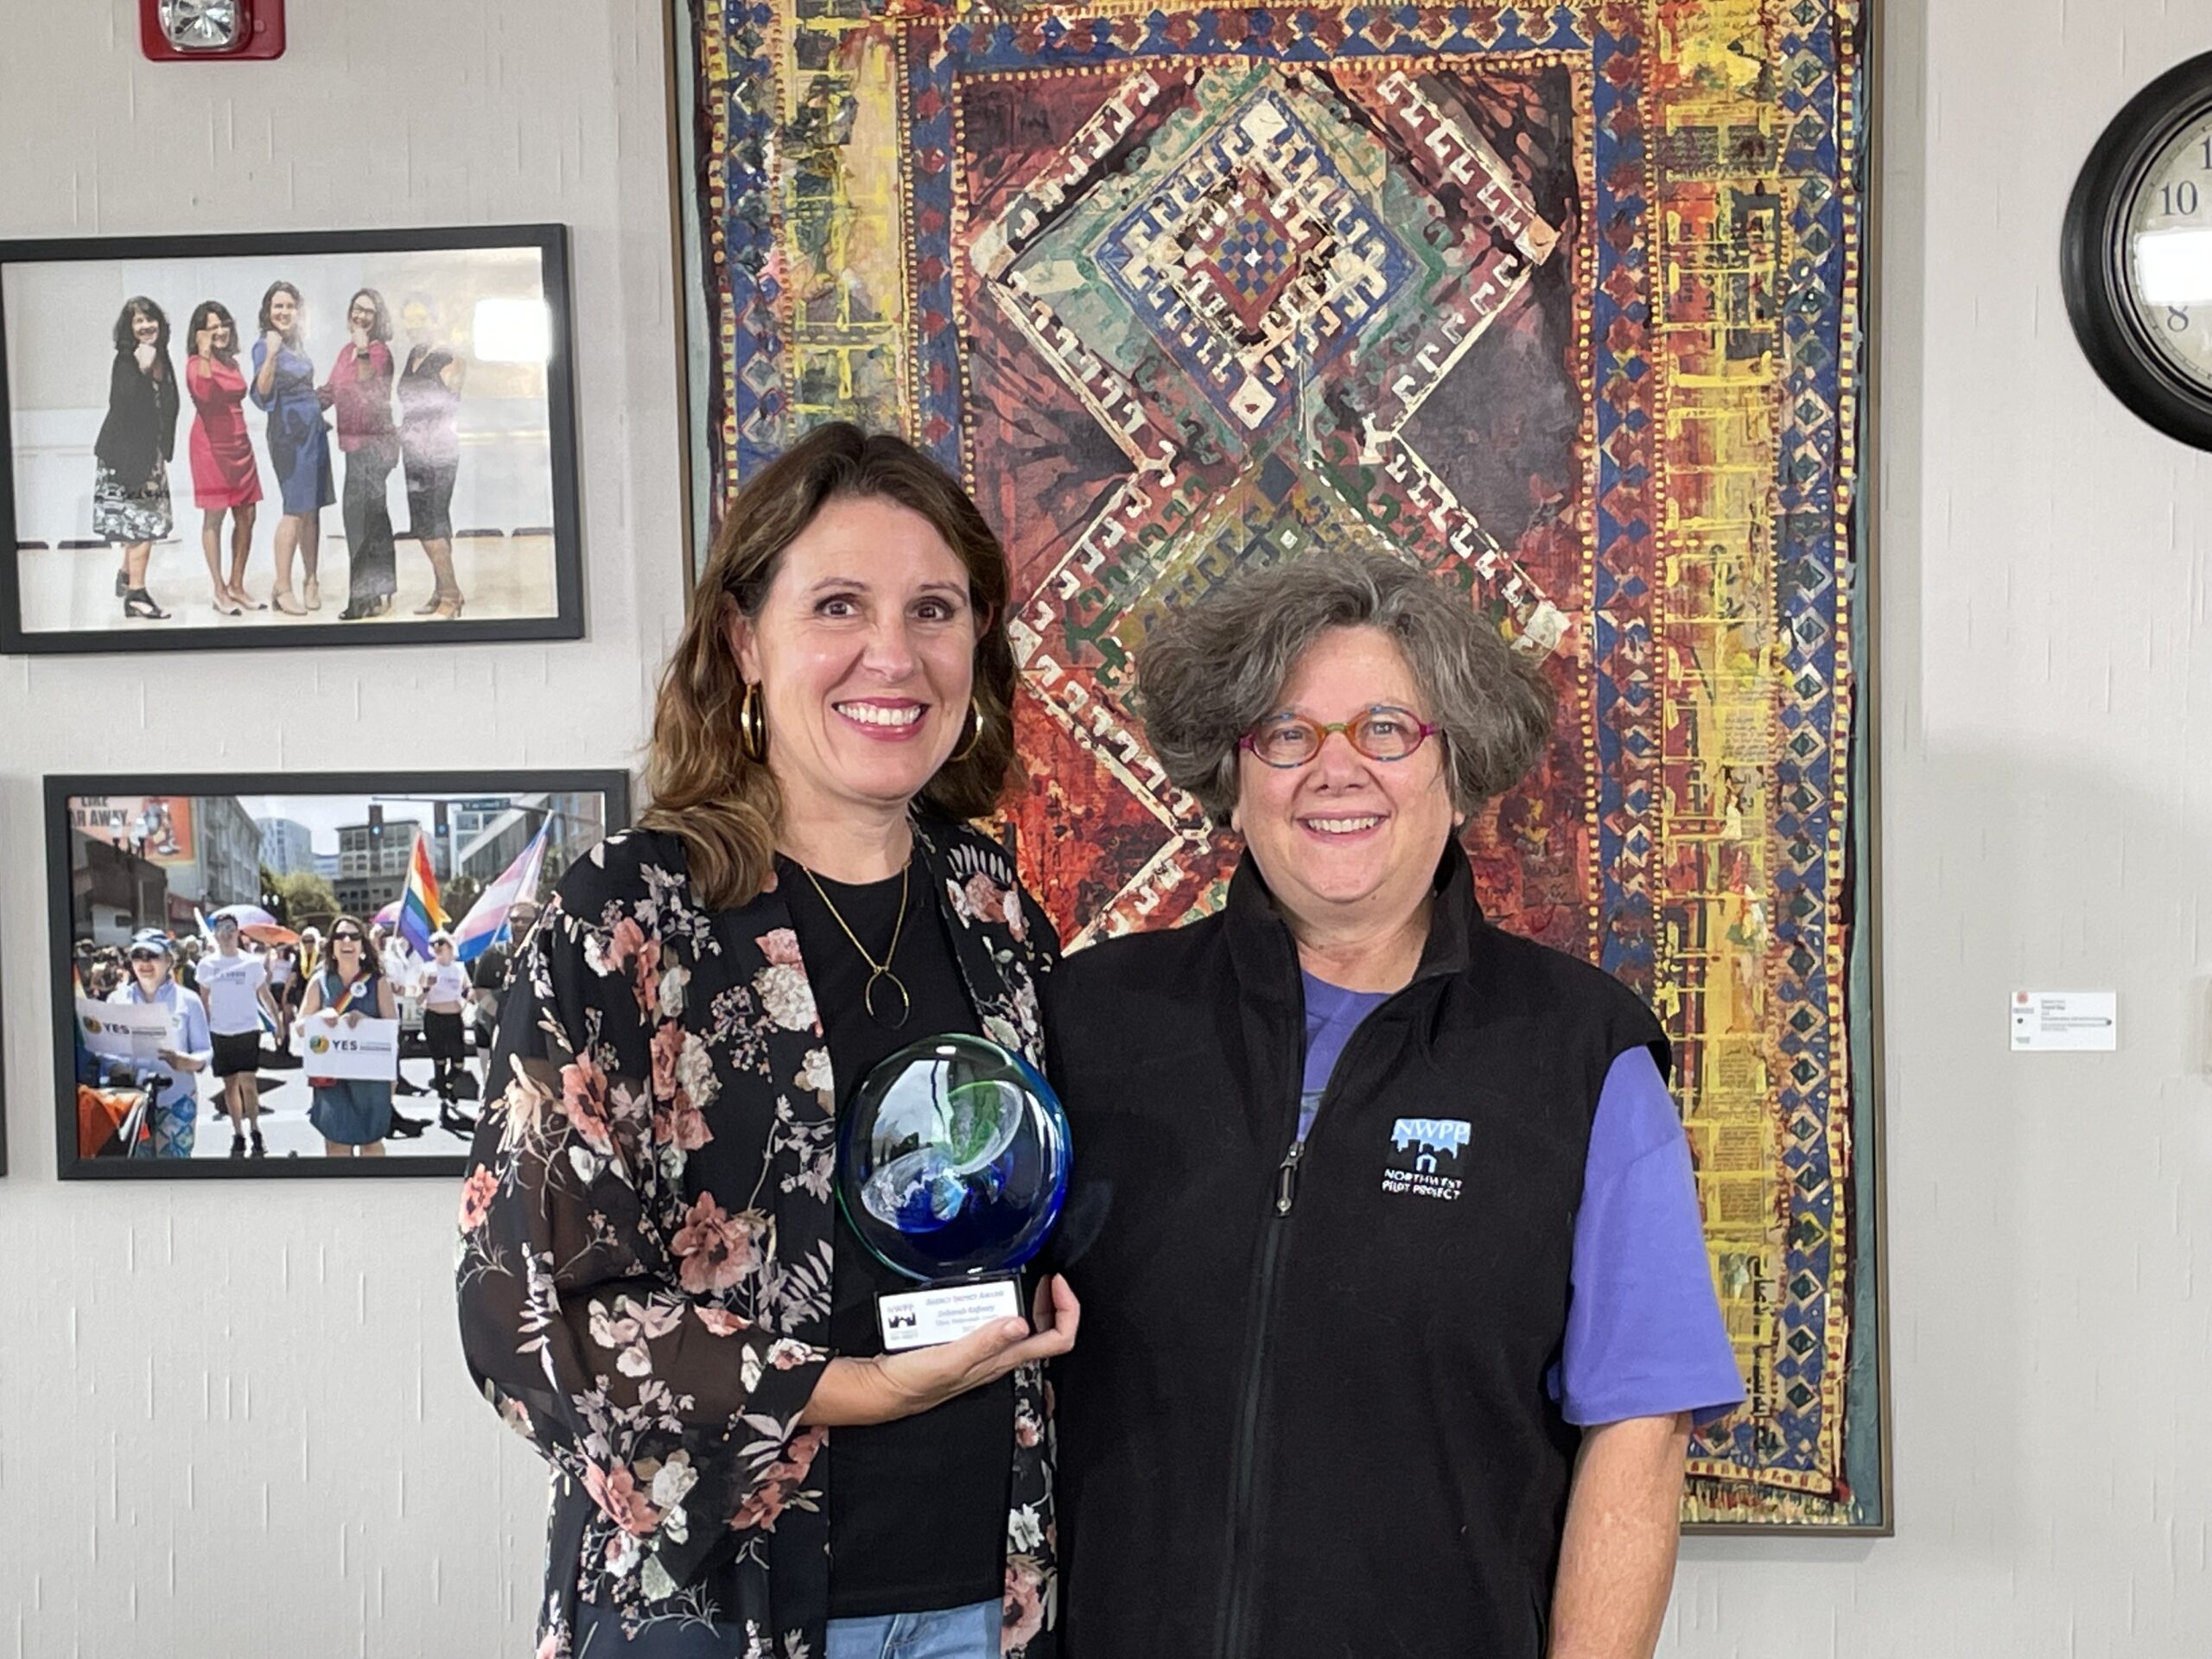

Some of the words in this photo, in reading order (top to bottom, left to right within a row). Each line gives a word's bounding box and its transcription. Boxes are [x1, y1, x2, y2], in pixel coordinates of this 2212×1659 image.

[2161, 180, 2198, 216] 10
[103, 1022, 130, 1035] YES
[332, 1039, 359, 1052] YES
[1395, 1120, 1468, 1141] NWPP
[1384, 1168, 1463, 1189] NORTHWEST
[1382, 1179, 1411, 1193] PILOT
[1413, 1184, 1461, 1200] PROJECT
